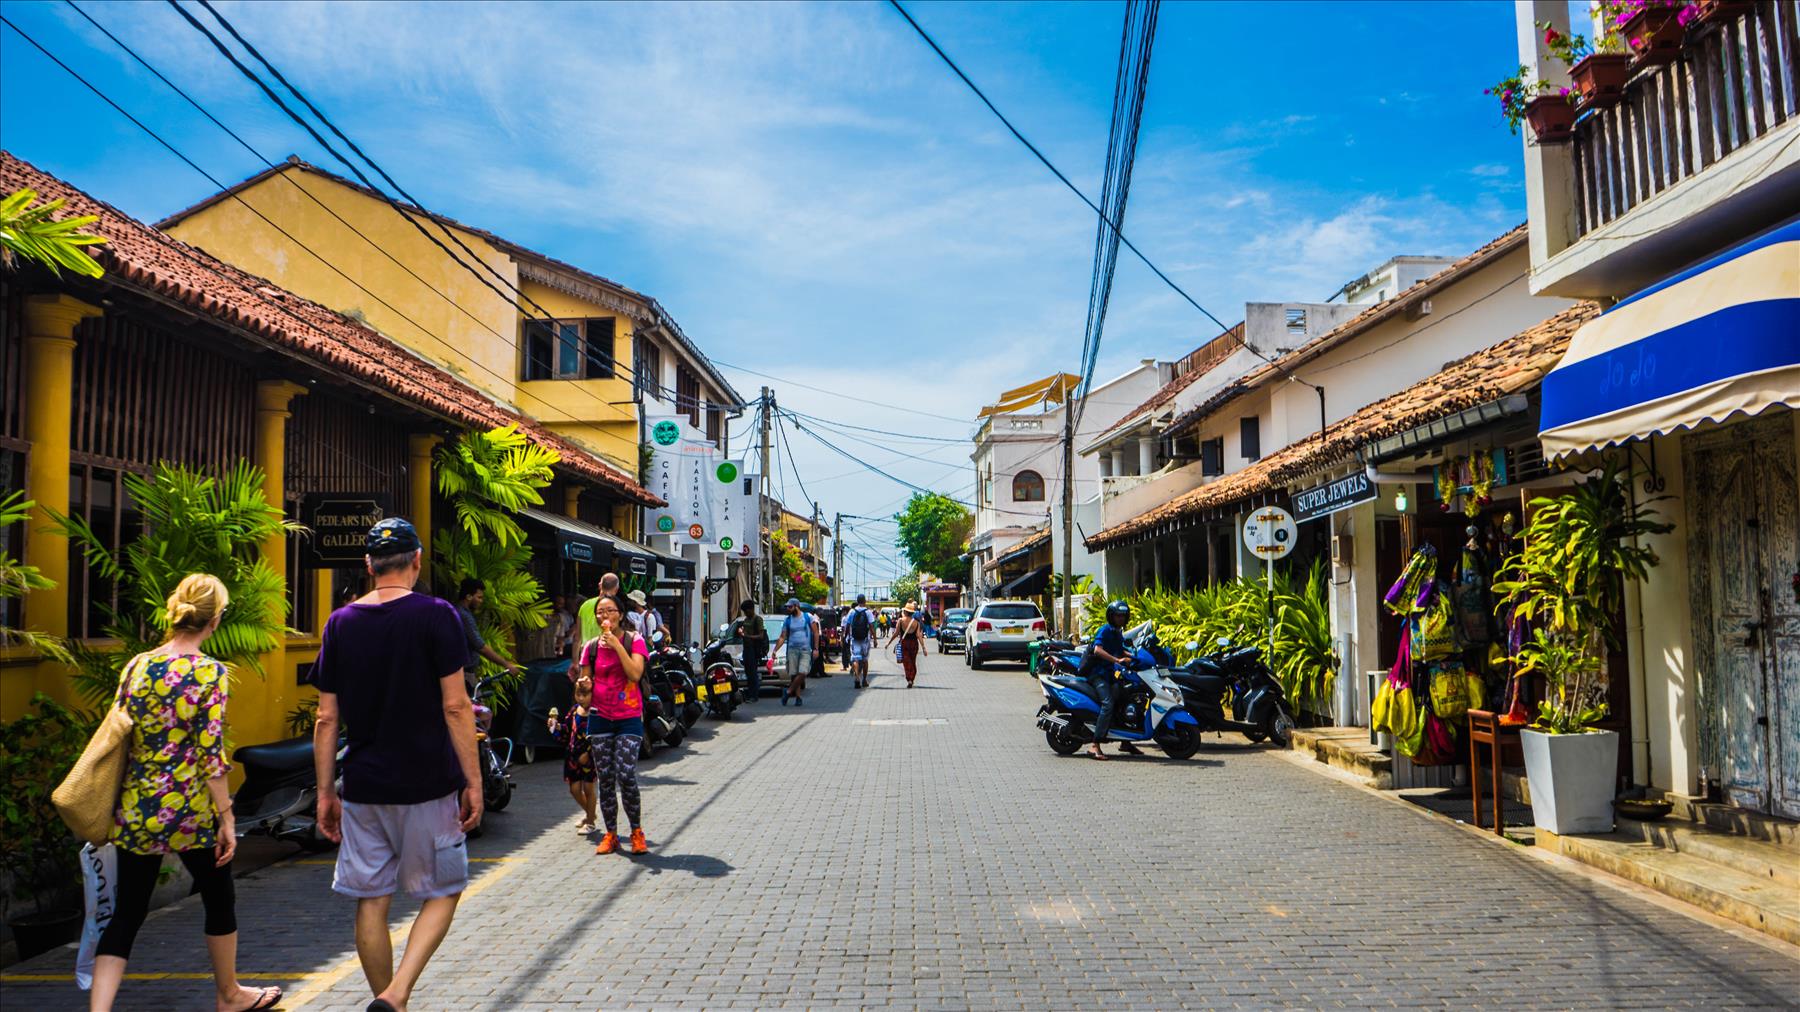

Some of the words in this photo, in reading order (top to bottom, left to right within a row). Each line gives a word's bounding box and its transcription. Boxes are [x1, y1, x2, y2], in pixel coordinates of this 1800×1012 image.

[662, 460, 670, 501] CAFE
[1297, 487, 1327, 513] SUPER
[1328, 473, 1368, 502] JEWELS
[361, 514, 380, 527] INN
[690, 527, 703, 536] 63
[322, 533, 368, 547] GALLER
[720, 539, 732, 548] 63
